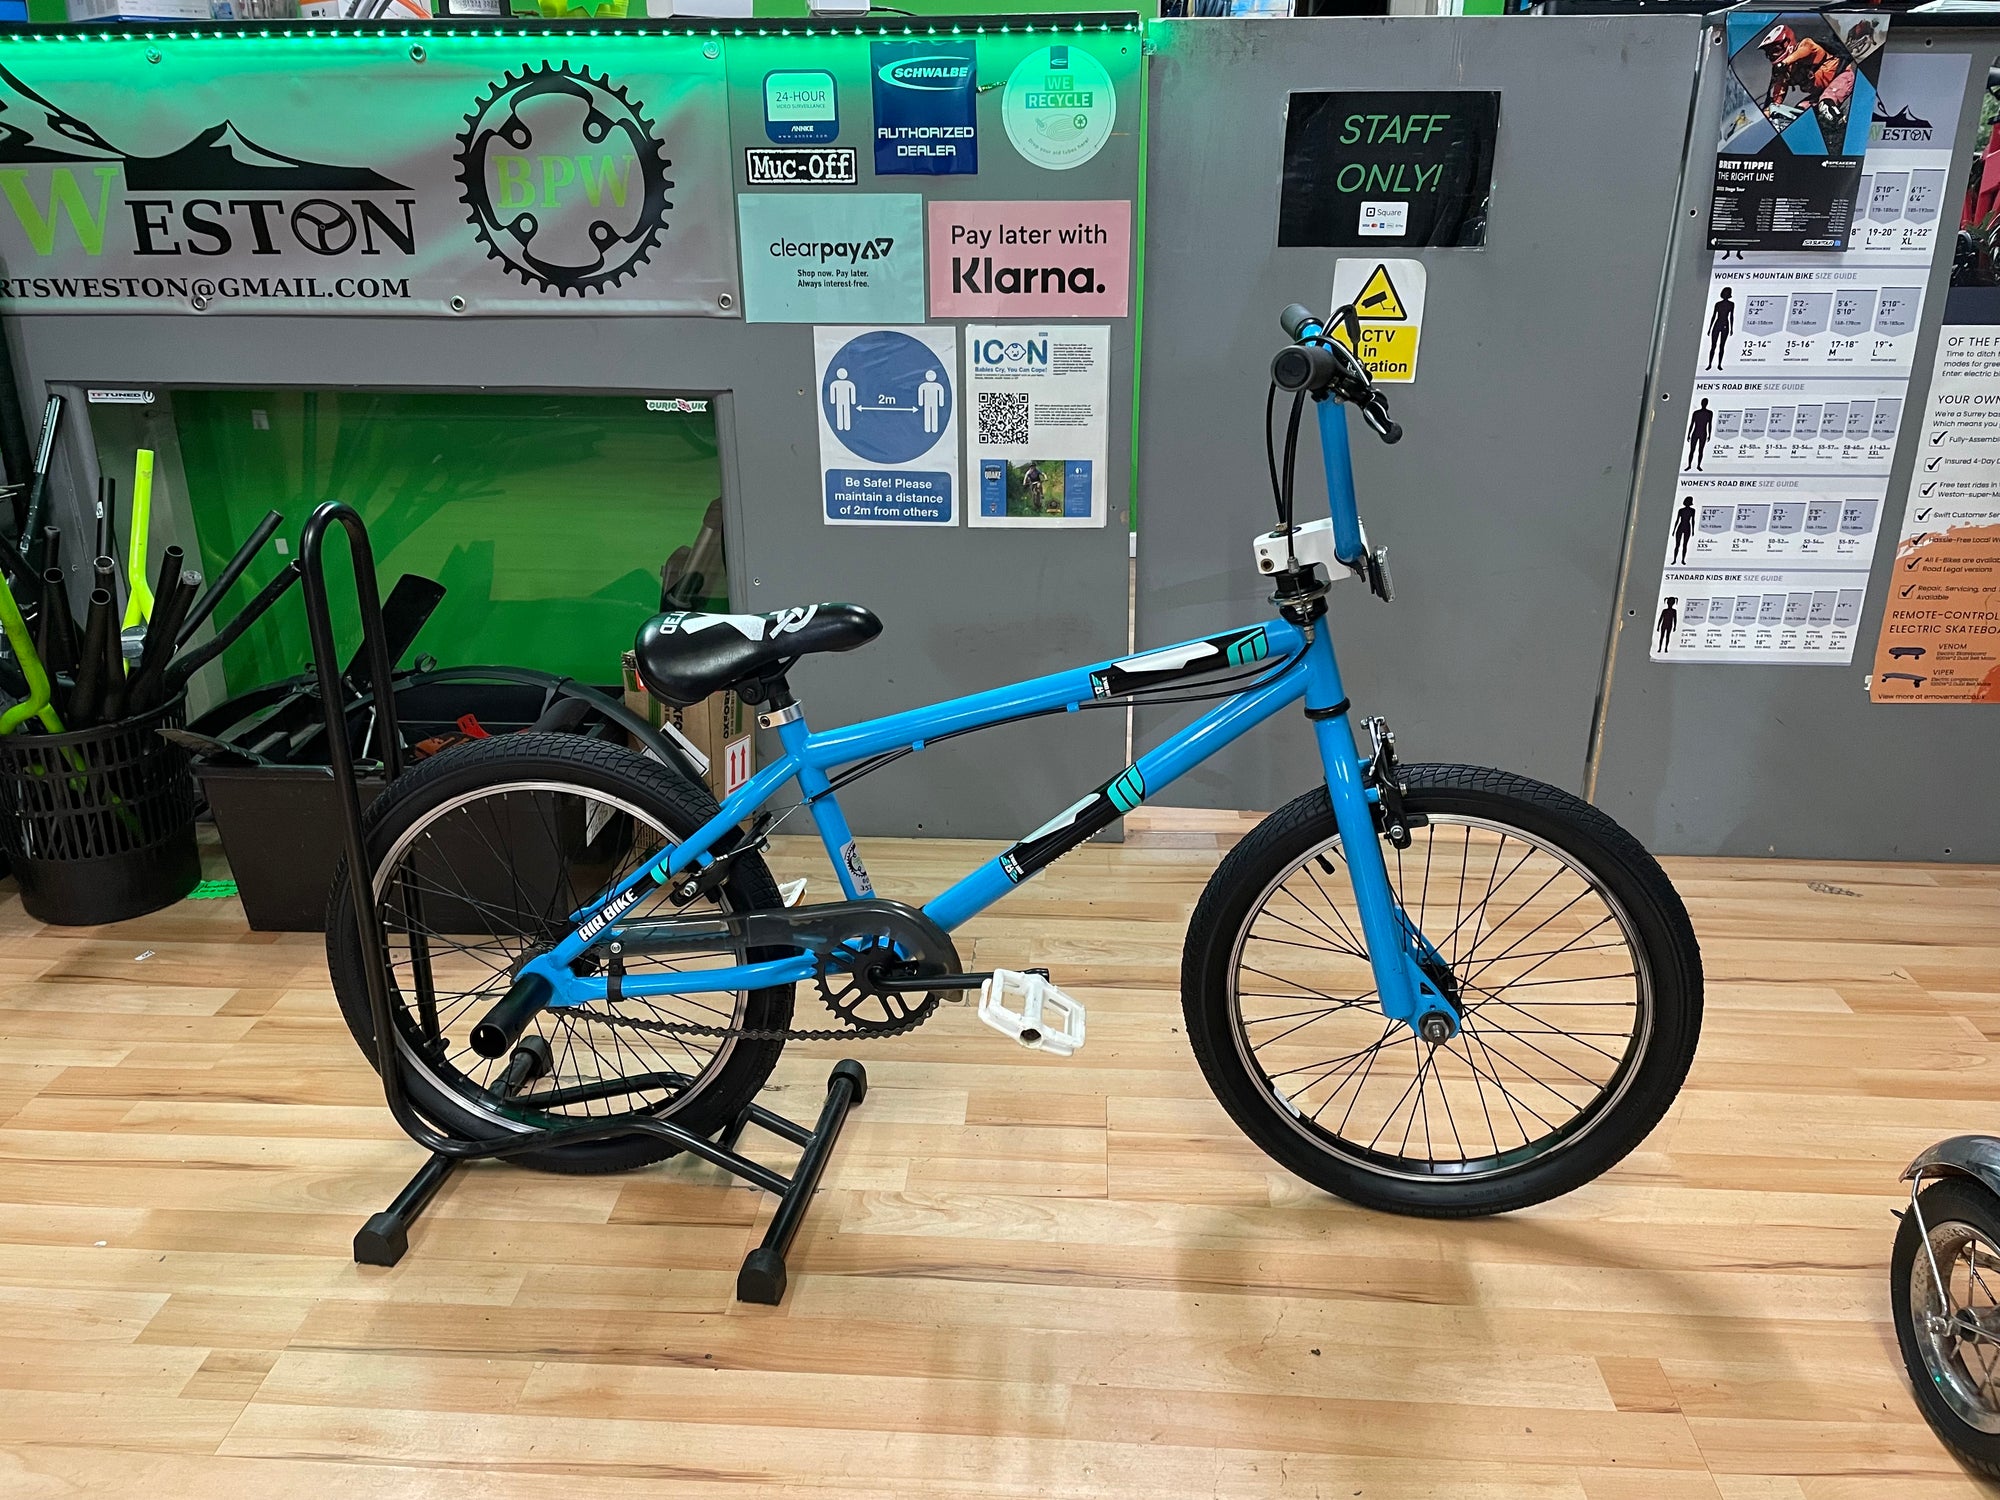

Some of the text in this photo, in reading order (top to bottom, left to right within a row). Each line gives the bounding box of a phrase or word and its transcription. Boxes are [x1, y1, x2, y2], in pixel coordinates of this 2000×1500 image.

[894, 66, 968, 79] SCHWALBE
[1047, 76, 1071, 89] WE
[776, 91, 826, 102] 24-HOUR
[1028, 93, 1090, 107] RECYCLE
[878, 126, 974, 139] AUTHORIZED
[1339, 114, 1451, 145] STAFF
[897, 144, 956, 156] DEALER
[753, 154, 851, 179] Muc-Off
[1718, 160, 1774, 170] BRETT TIPPIE
[493, 155, 634, 209] BPW
[1336, 163, 1444, 193] ONLY!
[1718, 171, 1775, 181] THE RIGHT LINE
[0, 166, 416, 256] WESTON
[1377, 208, 1402, 217] Square
[951, 223, 1108, 249] Pay later with
[1901, 237, 1912, 245] XL
[770, 237, 862, 263] clearpay
[797, 269, 814, 278] Shop
[836, 269, 849, 279] Pay
[850, 269, 869, 277] later.
[952, 257, 1106, 294] Klarna.
[1795, 272, 1814, 280] BIKE
[1815, 272, 1832, 280] SIZE
[1834, 272, 1857, 280] GUIDE
[797, 279, 870, 288] Always interest-free.
[1361, 329, 1396, 343] CTV
[1948, 337, 1990, 346] OF THE
[1363, 344, 1377, 357] in
[1364, 360, 1407, 373] ration
[878, 395, 896, 405] 2m
[1938, 395, 1970, 404] YOUR
[1963, 410, 1986, 419] Surrey
[1984, 421, 1998, 429] you
[1944, 457, 1995, 466] Insured 4-Day
[845, 477, 933, 490] Be Safe! Please
[1739, 480, 1757, 488] BIKE
[1758, 480, 1775, 488] SIZE
[1776, 480, 1799, 488] GUIDE
[834, 491, 943, 504] maintain a distance
[839, 505, 939, 518] of 2m from others
[1934, 511, 1987, 519] Swift Customer
[1943, 566, 1963, 574] Legal
[1892, 610, 1999, 620] REMOTE-CONTROL
[1889, 624, 1942, 634] ELECTRIC
[578, 888, 638, 941] AIR BIKE
